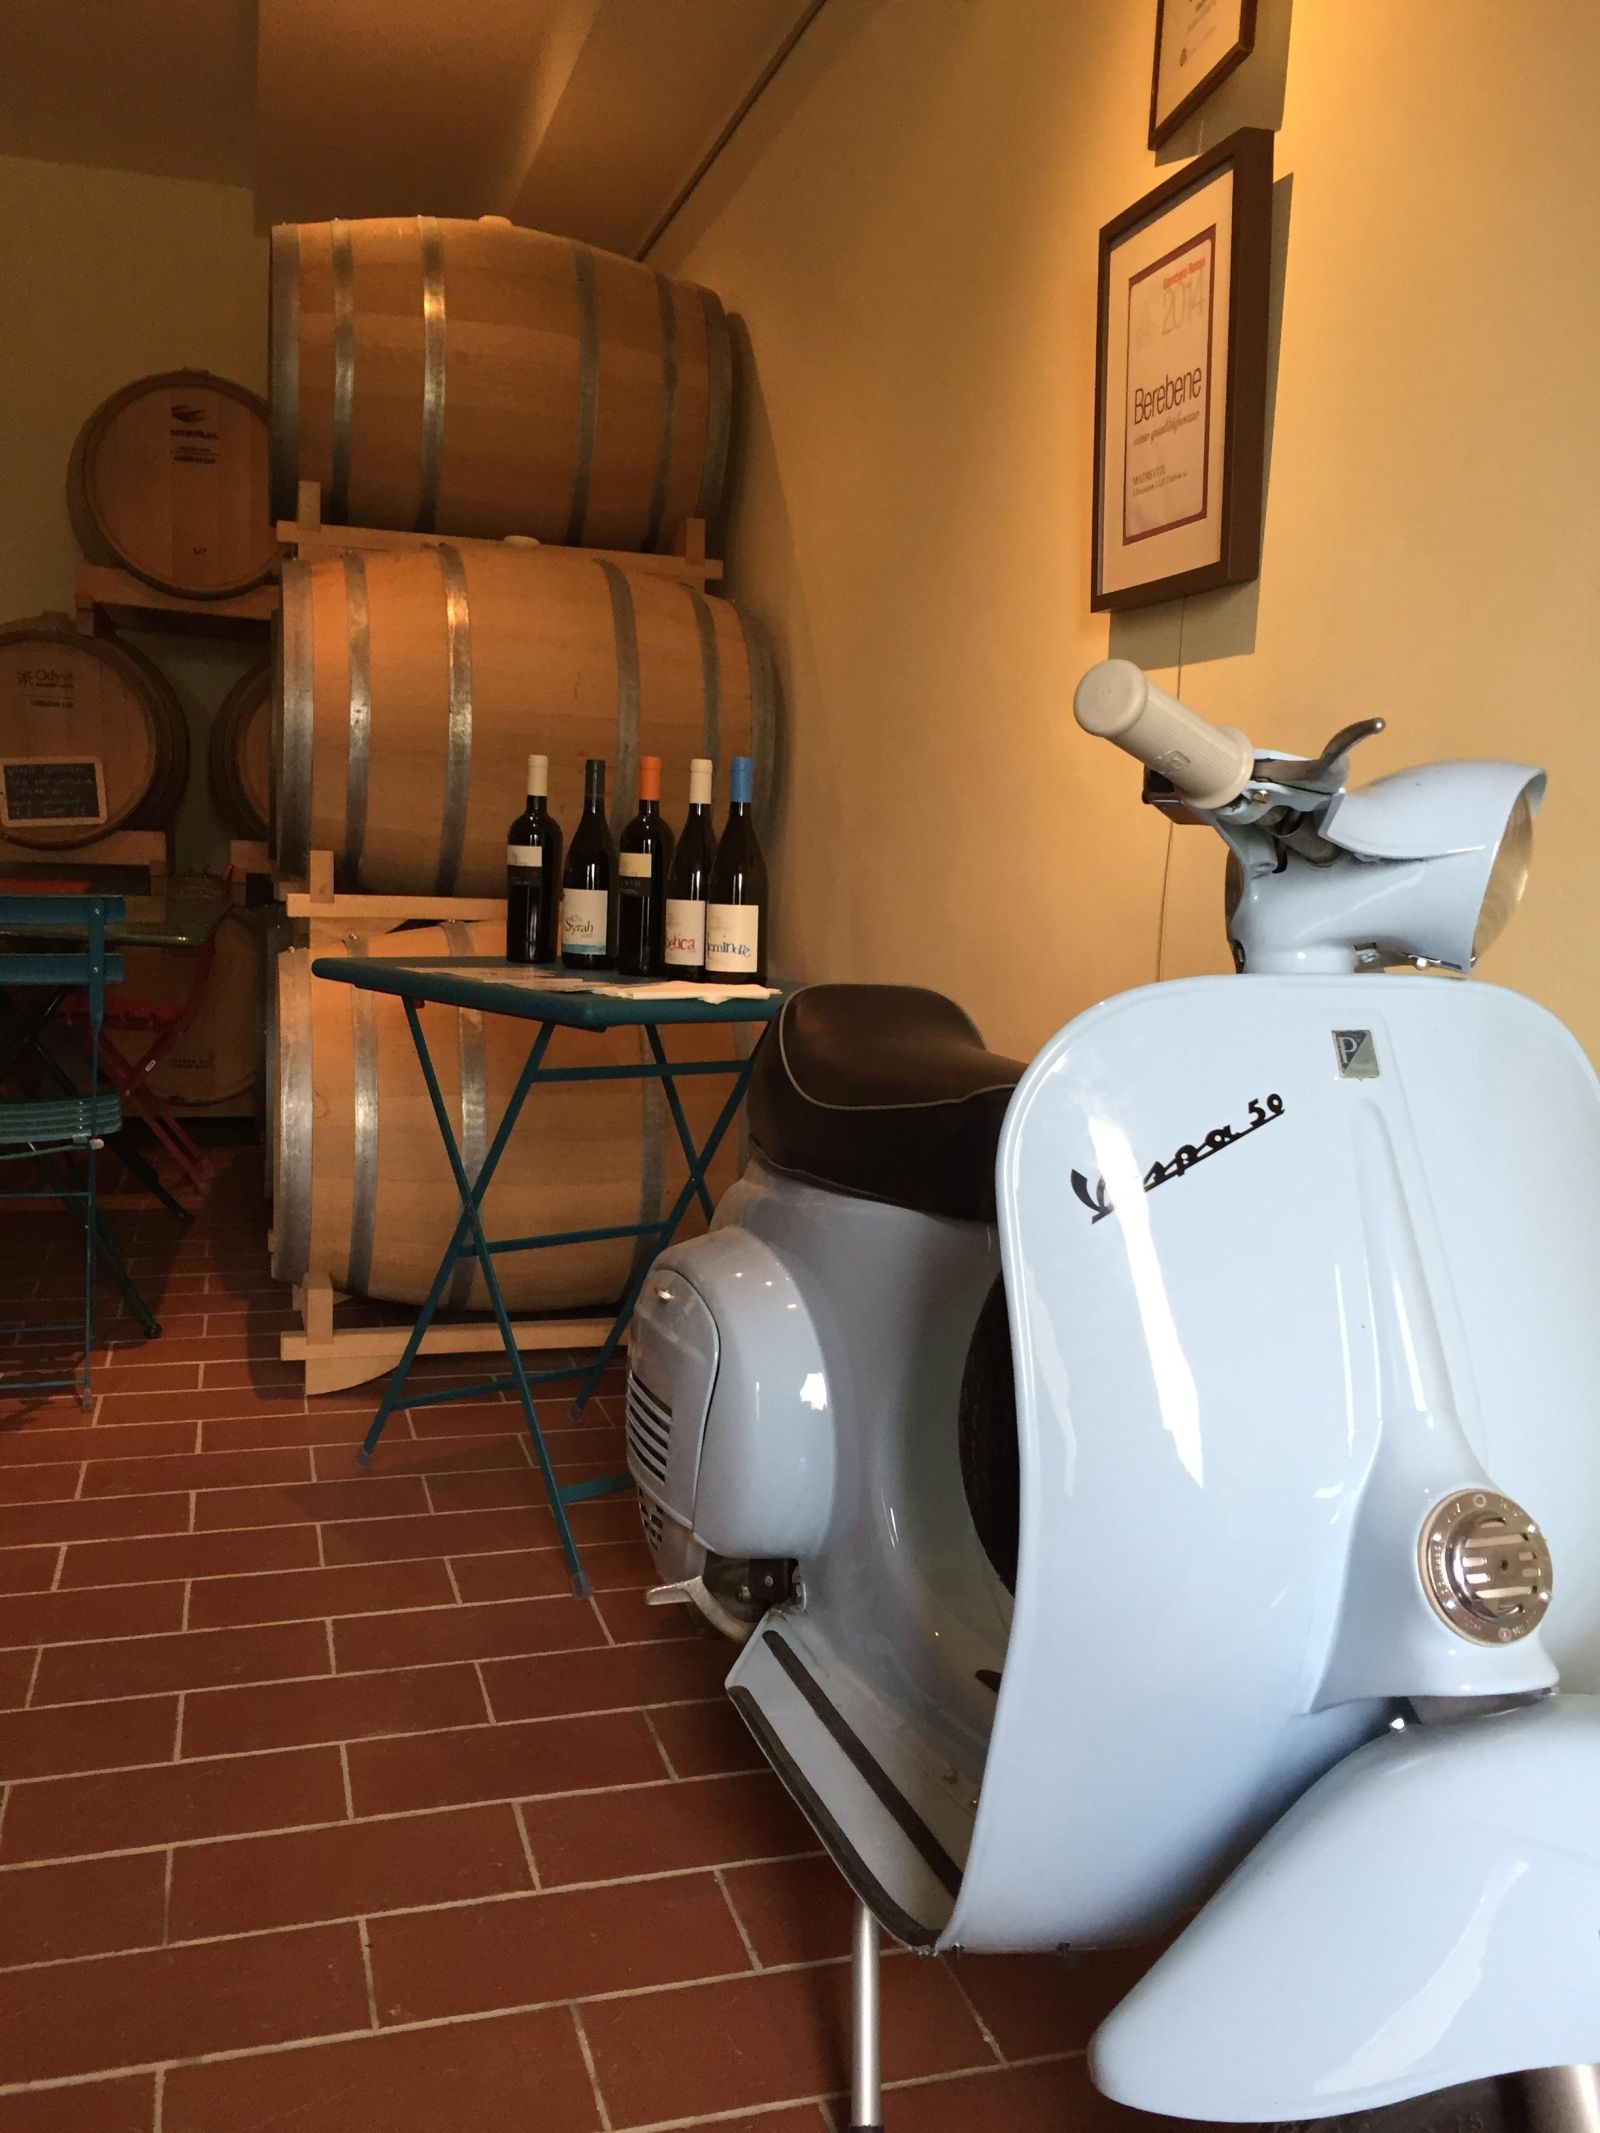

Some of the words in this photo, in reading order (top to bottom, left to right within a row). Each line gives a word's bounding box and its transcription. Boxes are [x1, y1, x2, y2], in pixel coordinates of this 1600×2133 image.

[1161, 269, 1205, 336] 2014
[1134, 367, 1202, 425] Berebene
[564, 919, 594, 936] Syrah
[1247, 1093, 1285, 1127] 50
